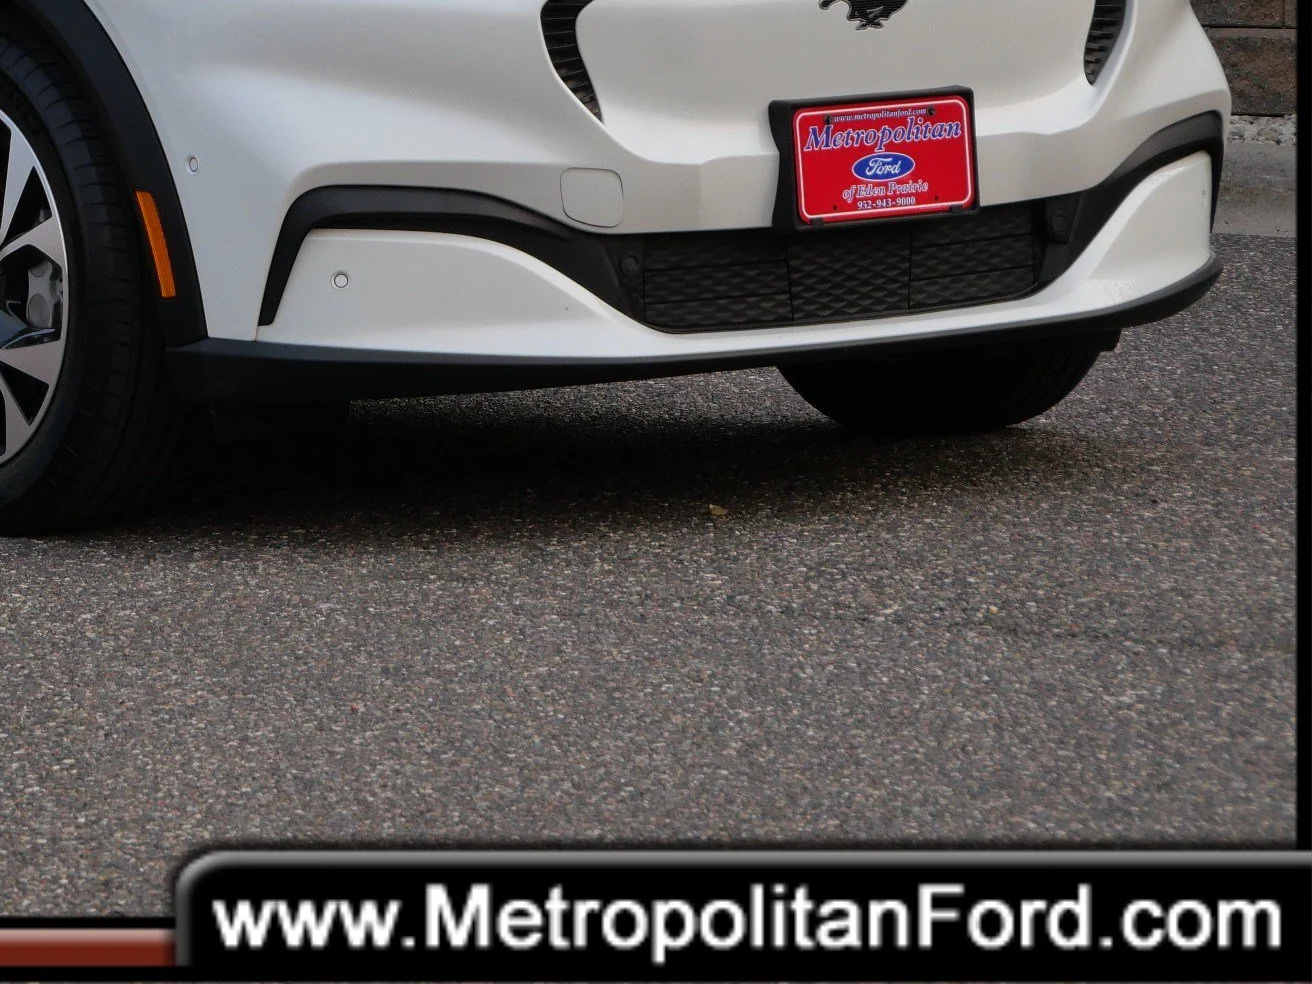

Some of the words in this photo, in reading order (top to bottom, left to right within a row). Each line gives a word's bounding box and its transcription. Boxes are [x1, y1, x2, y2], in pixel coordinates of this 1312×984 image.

[833, 107, 927, 122] www.metropolitanford.com
[803, 116, 962, 152] Metropolitan
[865, 157, 902, 176] Ford
[842, 185, 857, 204] of
[856, 183, 886, 198] Eden
[887, 179, 929, 195] Prairie
[857, 196, 916, 210] 952-943-9000
